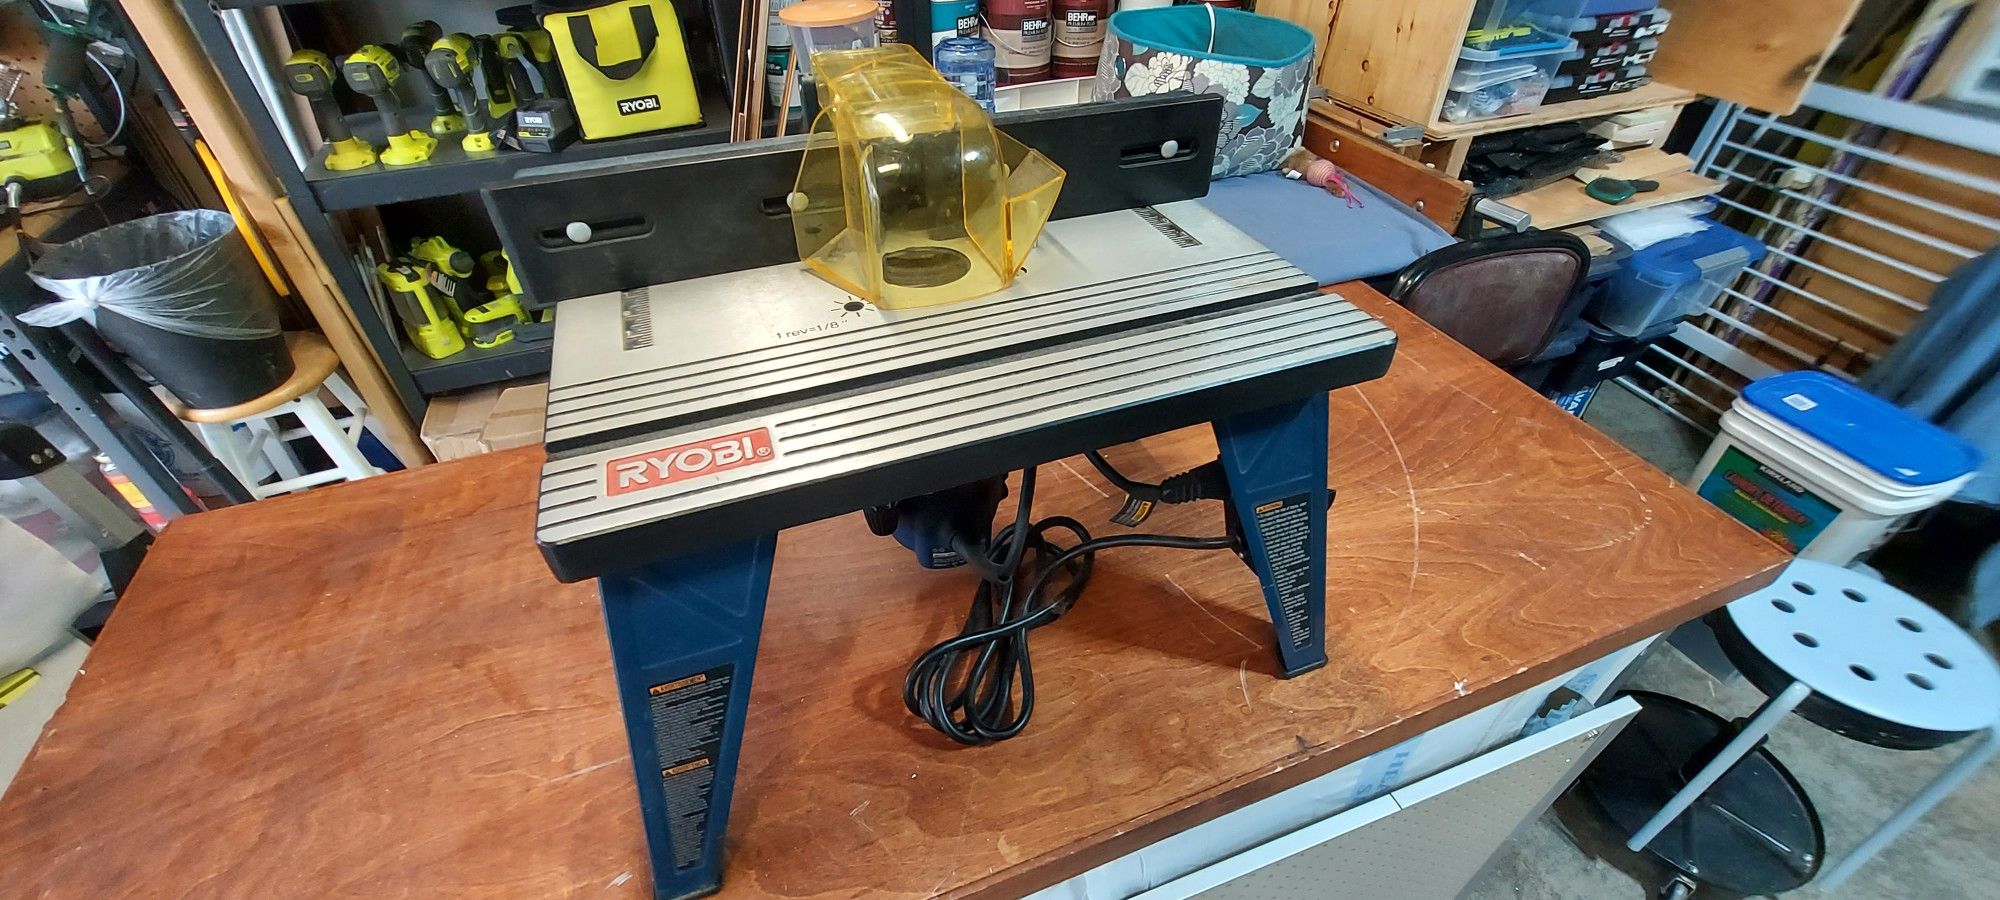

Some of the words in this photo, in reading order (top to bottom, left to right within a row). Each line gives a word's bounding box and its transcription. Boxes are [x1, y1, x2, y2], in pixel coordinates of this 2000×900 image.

[1067, 12, 1088, 22] BEHR
[958, 17, 975, 29] BEHR
[1023, 20, 1042, 31] BEHR
[619, 98, 658, 113] RYOBI
